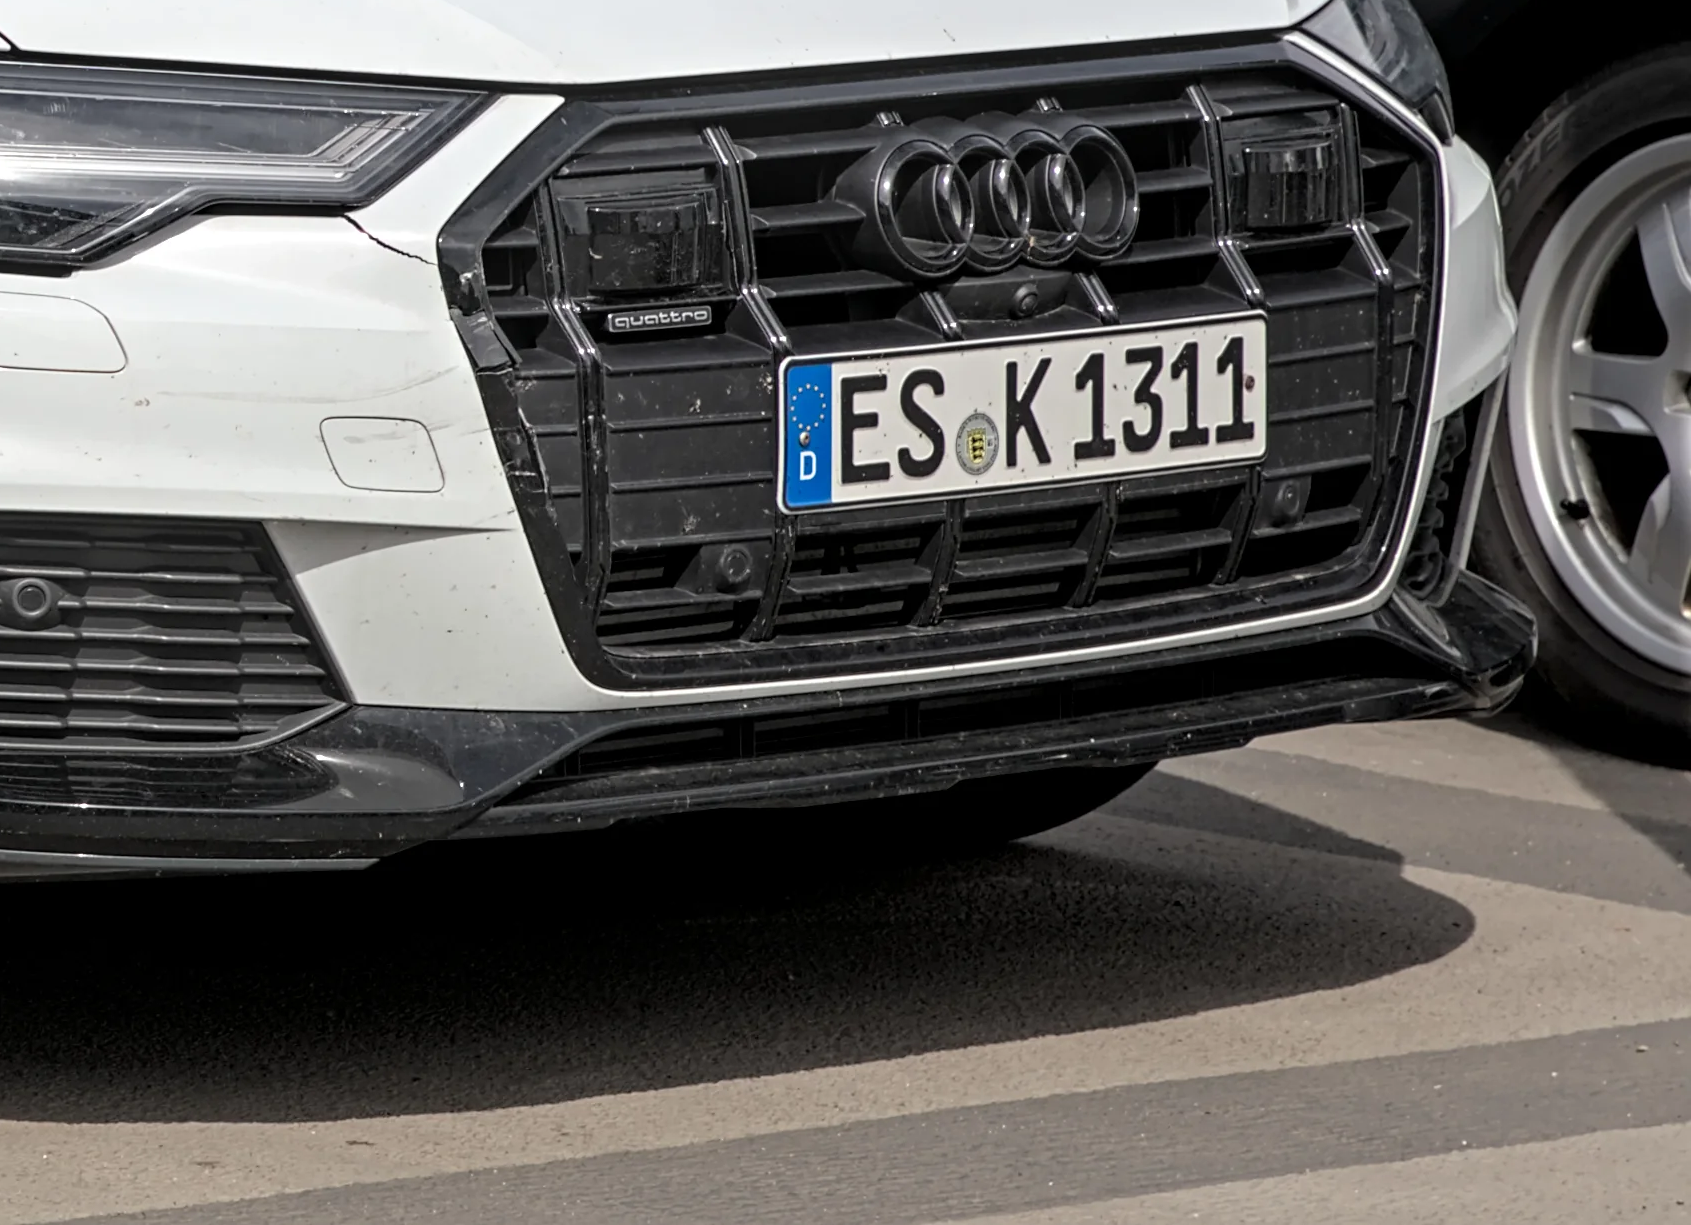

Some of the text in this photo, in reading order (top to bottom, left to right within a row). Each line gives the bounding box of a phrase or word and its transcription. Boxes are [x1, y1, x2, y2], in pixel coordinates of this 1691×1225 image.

[614, 310, 708, 329] quattro
[799, 450, 817, 481] D
[839, 368, 946, 485] ES
[1005, 357, 1052, 468] K
[1074, 336, 1255, 461] 1311
